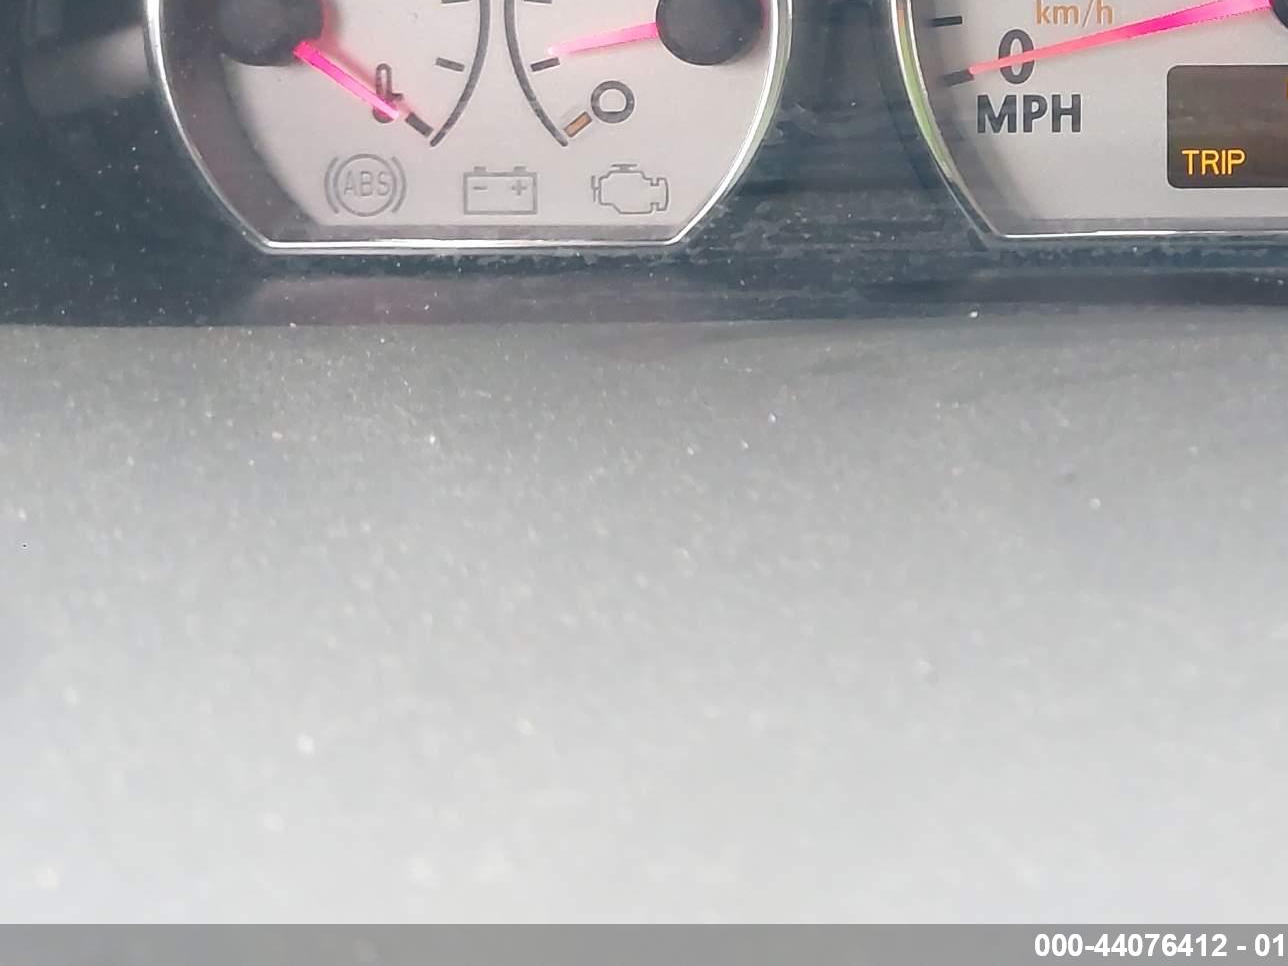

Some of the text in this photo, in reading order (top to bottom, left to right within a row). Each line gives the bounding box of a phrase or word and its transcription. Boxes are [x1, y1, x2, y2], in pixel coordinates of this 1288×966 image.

[999, 29, 1036, 86] 0
[976, 94, 1082, 133] MPH
[1182, 149, 1246, 176] TRIP
[344, 170, 391, 197] ABS
